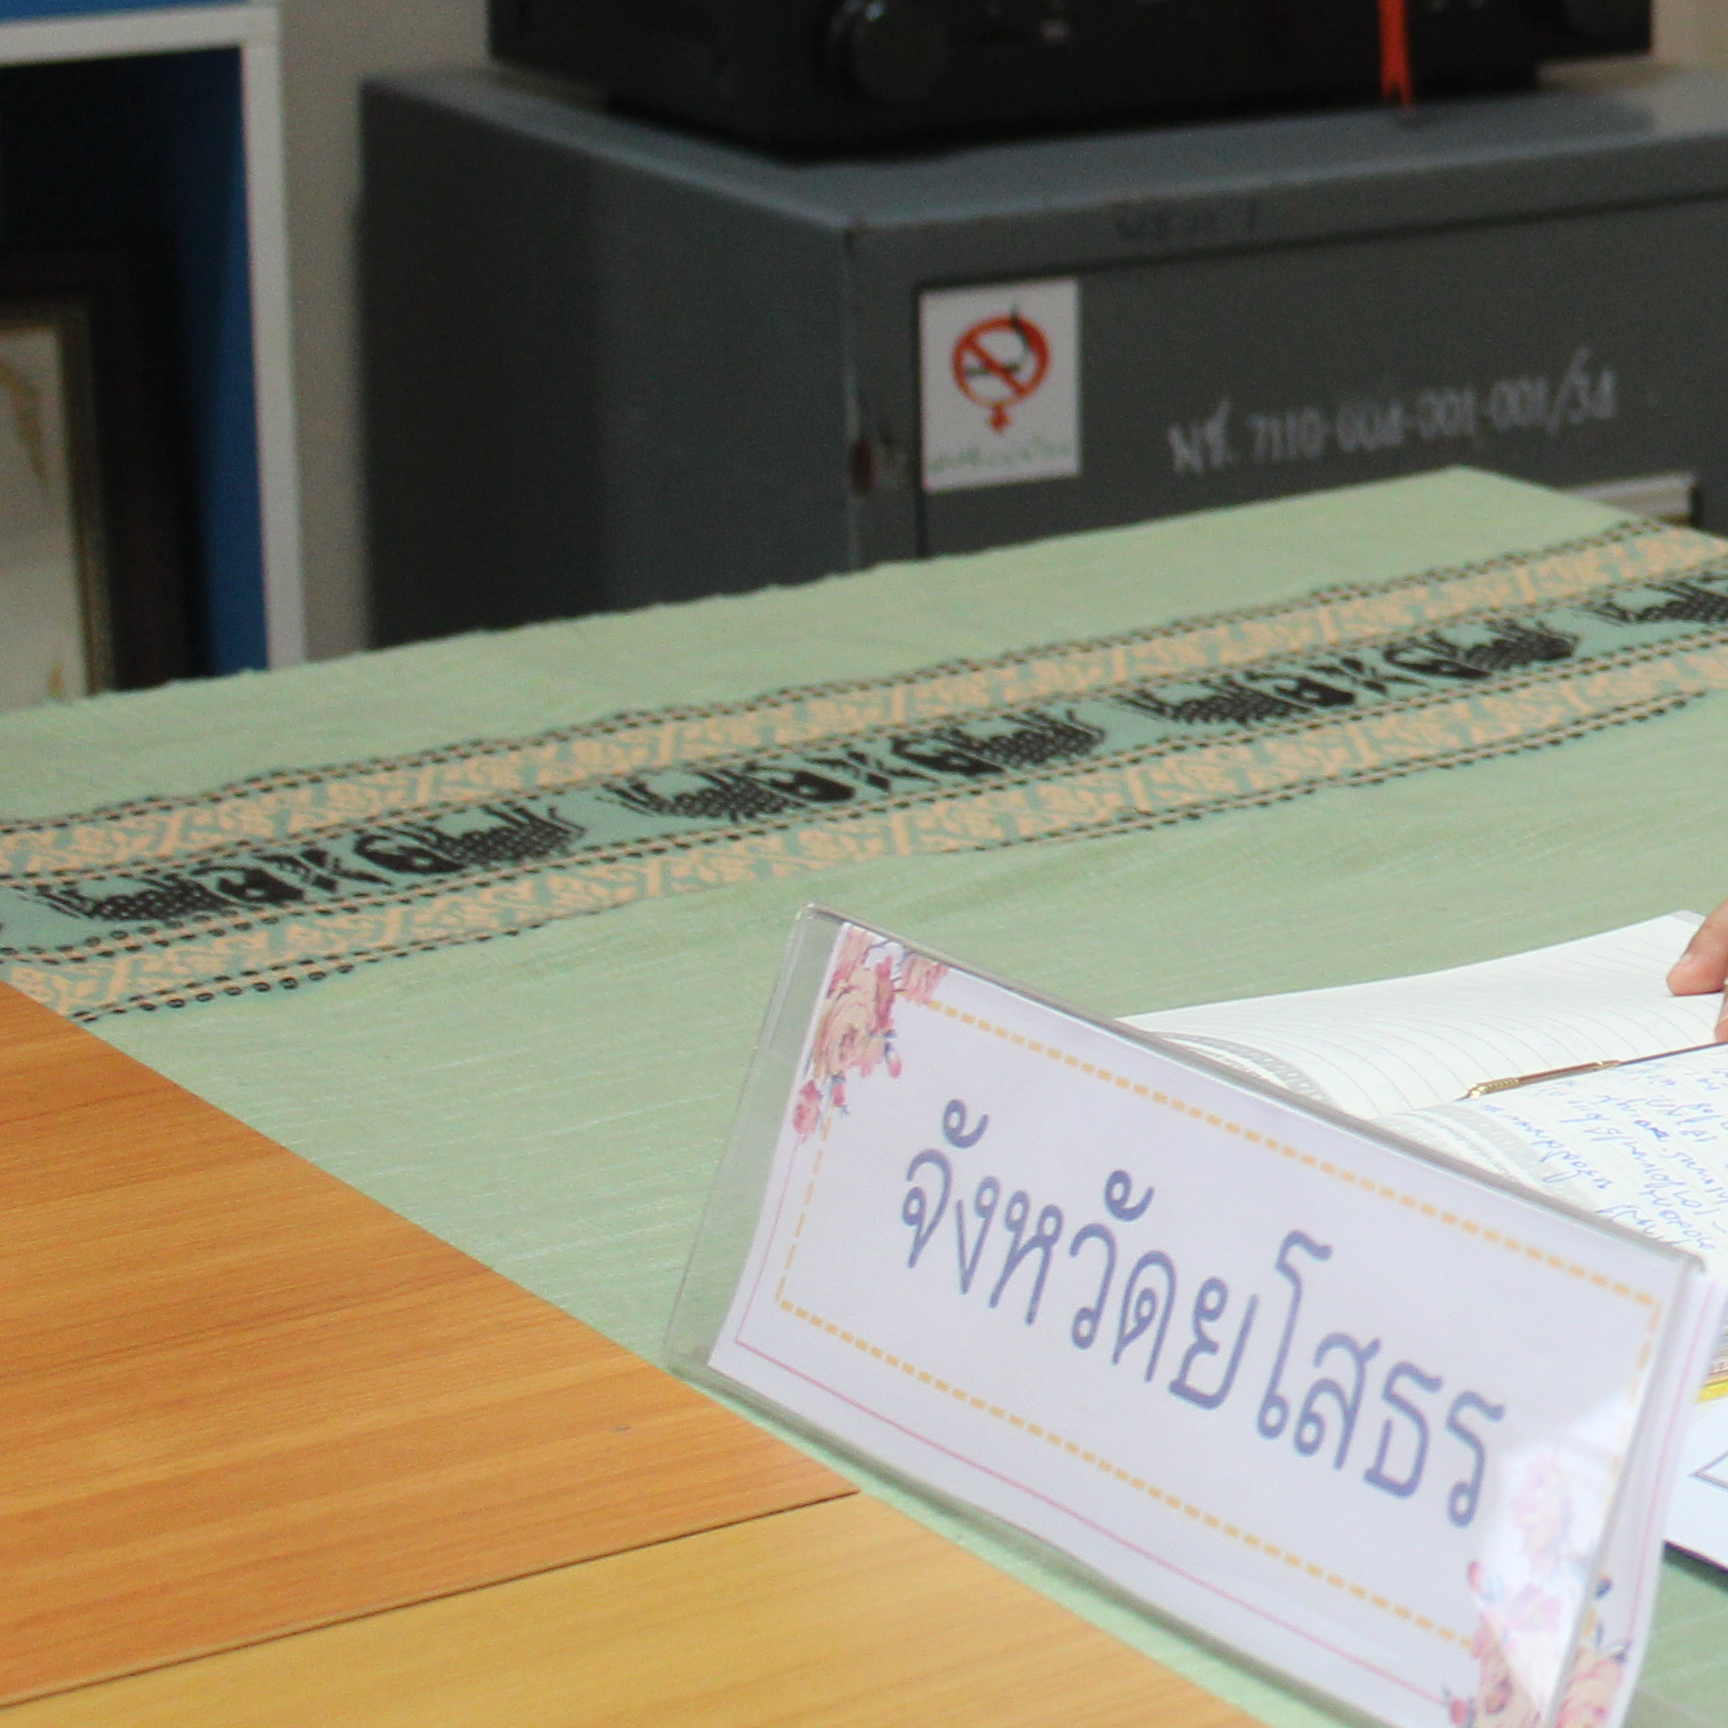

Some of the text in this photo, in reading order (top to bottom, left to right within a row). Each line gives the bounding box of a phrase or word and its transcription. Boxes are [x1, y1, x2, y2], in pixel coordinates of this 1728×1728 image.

[901, 1098, 1506, 1529] จังหวัดยโสธร
